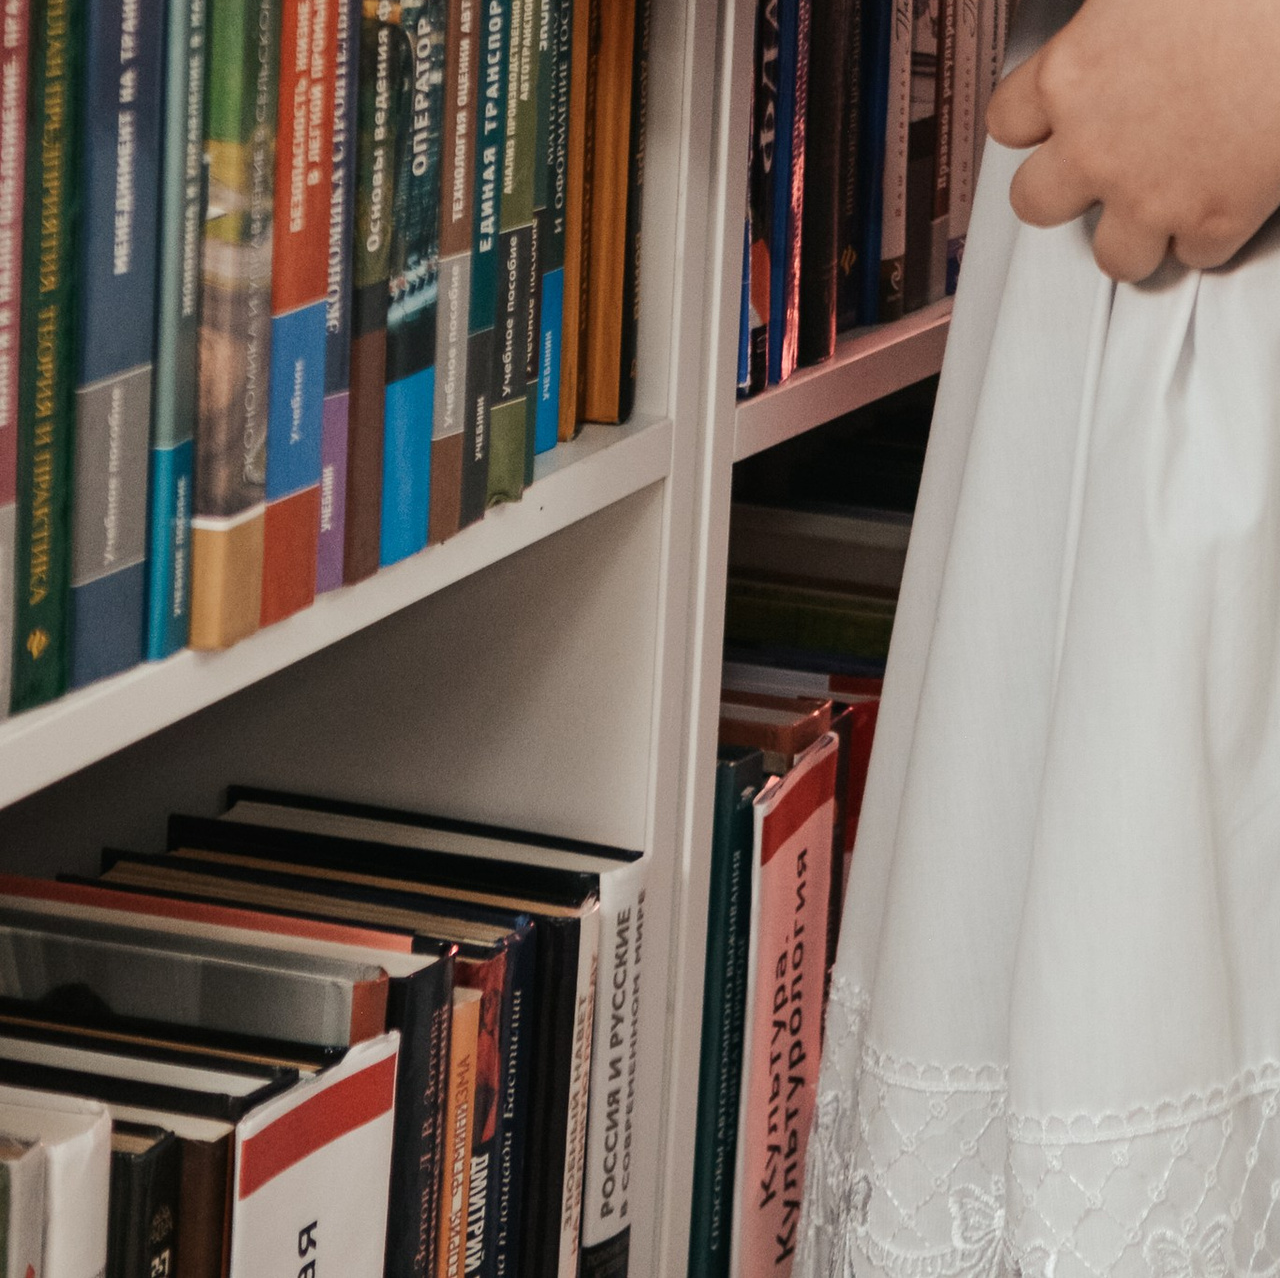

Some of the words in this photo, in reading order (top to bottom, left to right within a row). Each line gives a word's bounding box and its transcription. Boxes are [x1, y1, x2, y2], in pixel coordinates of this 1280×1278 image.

[118, 69, 138, 104] НА
[184, 55, 201, 180] УПРАВЛЕНИЕ
[307, 83, 324, 164] ЛЕГКОЙ
[374, 28, 390, 141] ведения
[411, 16, 432, 179] ОПЕРАТОР
[456, 38, 473, 108] ОЦЕНКИ
[290, 78, 308, 233] БЕЗОПАСНОСТЬ
[306, 169, 321, 187] В
[451, 110, 469, 223] ТЕХНОЛОГИЯ
[502, 139, 518, 195] АНАЛИЗ
[555, 59, 571, 210] ОФОРМЛЕНИЕ
[936, 103, 951, 191] Правовое
[111, 111, 136, 276] МЕНЕДЖМЕНТ
[365, 147, 386, 253] Основы
[478, 145, 497, 254] ЕДИНАЯ
[554, 216, 565, 234] И
[180, 204, 197, 317] ЭКОНОМИКА
[325, 167, 345, 334] ЭКОНОМИКА
[445, 264, 462, 344] пособие
[502, 236, 518, 322] пособие
[241, 326, 259, 484] ЭКОНОМИКА
[288, 359, 305, 445] Учебник
[442, 346, 458, 428] Учебное
[500, 328, 516, 397] Учебное
[541, 330, 553, 402] УЧЕБНИК
[105, 387, 122, 473] пособие
[472, 395, 486, 462] УЧЕБНИК
[29, 448, 51, 605] ПРАКТИКА
[102, 476, 119, 565] Учебное
[319, 464, 334, 533] УЧЕБНИК
[633, 887, 646, 966] МИРЕ
[724, 849, 743, 977] ВЫЖИВАНИЯ
[609, 906, 632, 1045] РУССКИЕ
[422, 1008, 441, 1105] Зотова
[502, 987, 523, 1119] Бастилии
[571, 992, 588, 1083] НАВЕТ
[606, 1057, 623, 1080] И
[620, 974, 643, 1193] СОВРЕМЕННОМ
[715, 982, 736, 1142] АВТОНОМНОГО
[757, 935, 790, 1211] Культура.
[774, 847, 810, 1266] Культурология
[450, 1054, 471, 1198] ФЕМИНИЗМА
[562, 1087, 583, 1232] ЗЛОБНЫЙ
[600, 1087, 622, 1220] РОССИЯ
[464, 1152, 490, 1273] ДМИТРИЙ
[496, 1129, 513, 1247] площади
[619, 1199, 629, 1219] В
[708, 1145, 727, 1252] СПОСОБЫ
